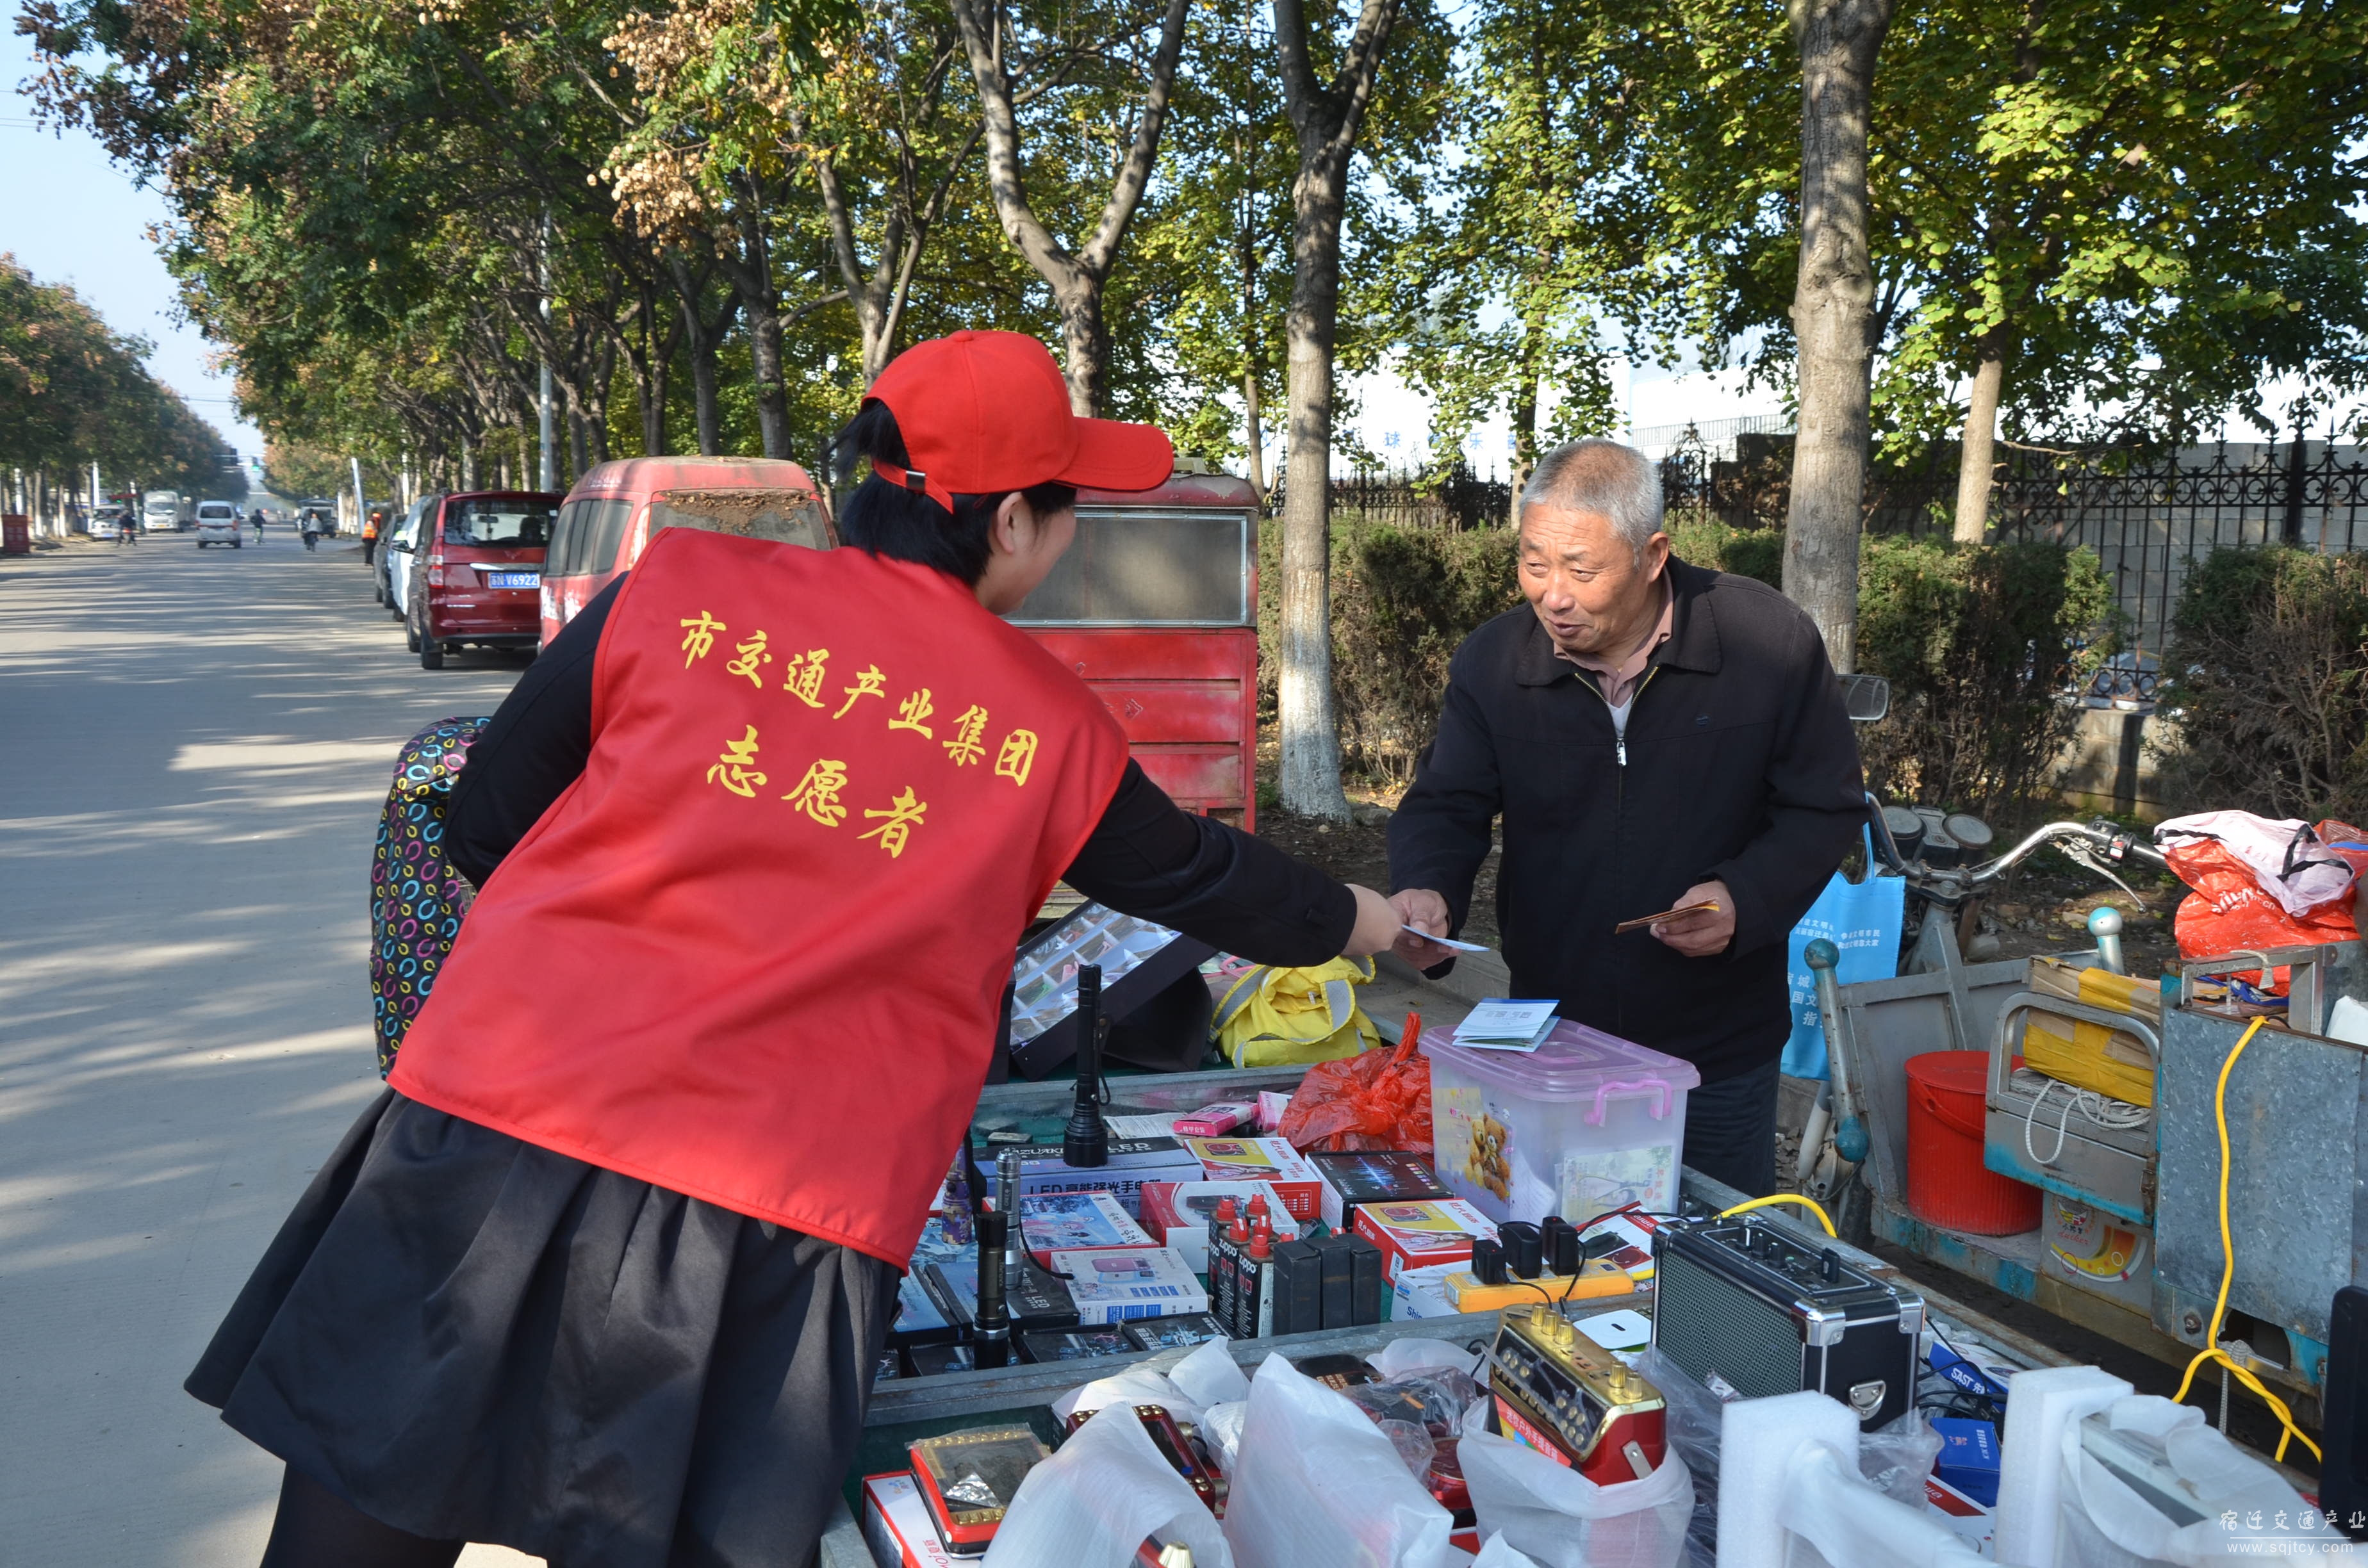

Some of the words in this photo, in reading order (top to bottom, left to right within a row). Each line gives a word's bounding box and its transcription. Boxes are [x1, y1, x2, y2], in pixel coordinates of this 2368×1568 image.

[680, 610, 1039, 787] 市交通产业集团
[707, 724, 928, 858] 志愿者
[1219, 1238, 1237, 1257] Zippo
[1239, 1254, 1256, 1273] Zippo
[1950, 1367, 1975, 1387] SAST
